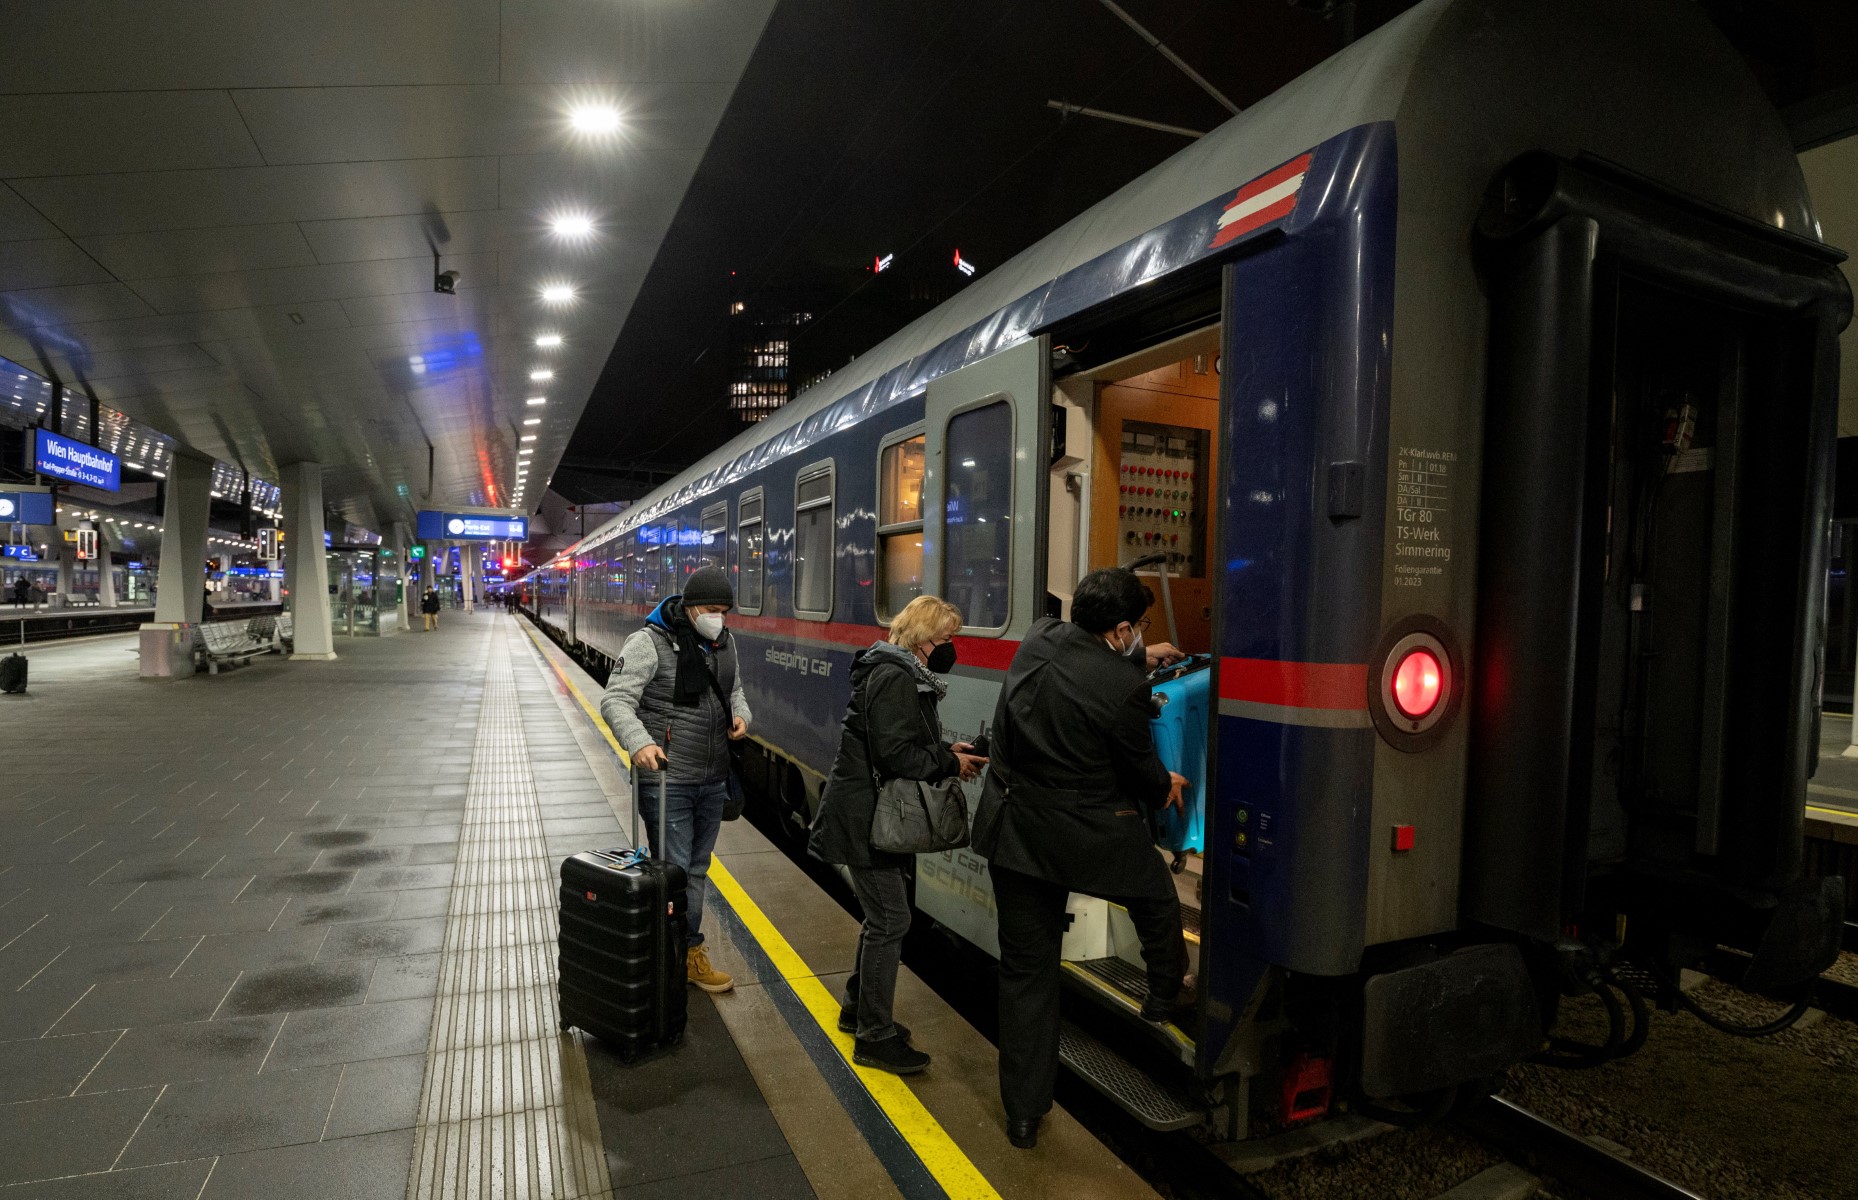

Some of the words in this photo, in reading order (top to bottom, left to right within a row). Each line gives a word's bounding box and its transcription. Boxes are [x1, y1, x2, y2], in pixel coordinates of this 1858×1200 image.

[47, 439, 66, 459] Wien
[68, 446, 114, 473] Hauptbahnhof
[1398, 459, 1408, 469] Pn
[1398, 472, 1409, 481] Sm
[1397, 496, 1408, 505] DA
[1397, 508, 1416, 522] TGr
[1419, 510, 1432, 523] 80
[1397, 526, 1440, 541] TS-Werk
[9, 546, 17, 556] 7
[1395, 542, 1451, 561] Simmering
[486, 561, 491, 569] 5
[1394, 564, 1443, 577] Foliengarantie
[1394, 577, 1422, 587] 01.2023
[765, 645, 809, 676] sleeping
[811, 658, 833, 677] car
[957, 852, 987, 876] car
